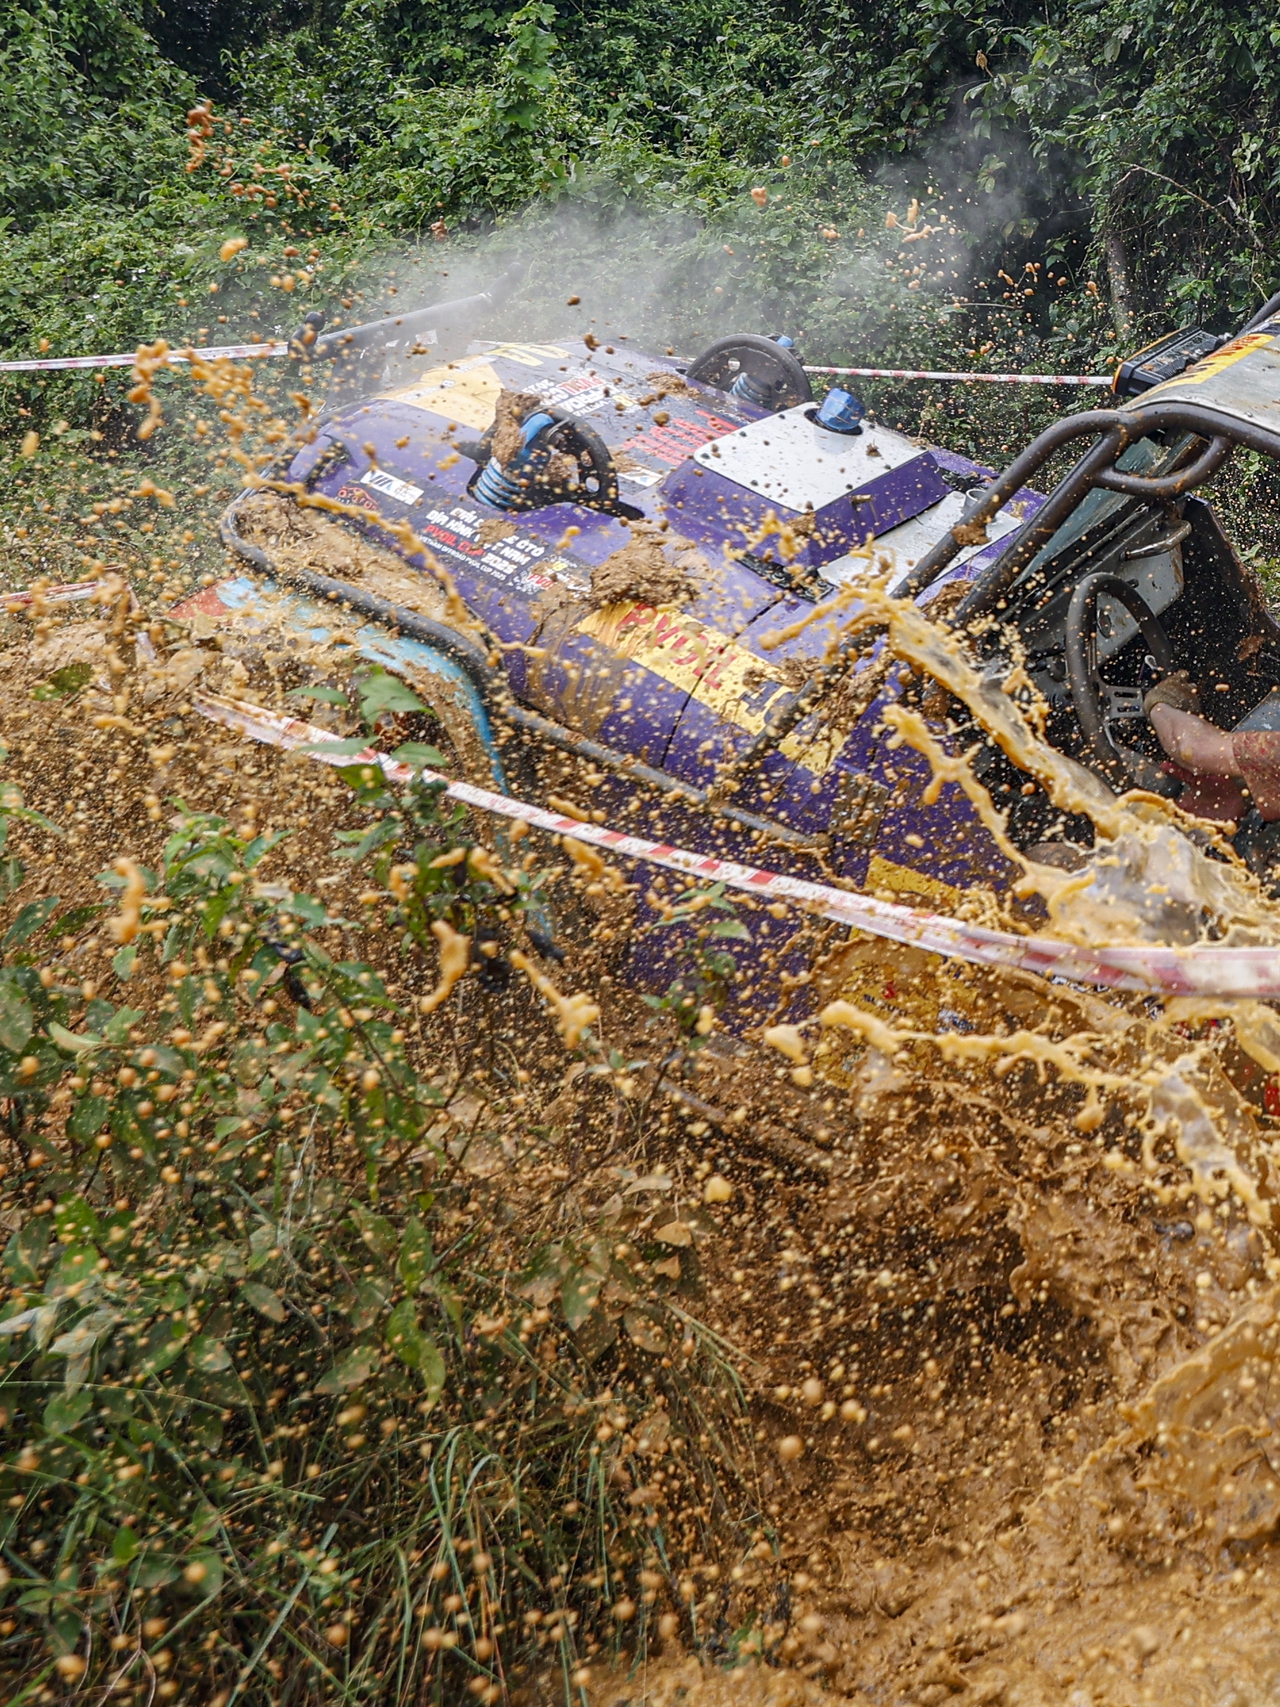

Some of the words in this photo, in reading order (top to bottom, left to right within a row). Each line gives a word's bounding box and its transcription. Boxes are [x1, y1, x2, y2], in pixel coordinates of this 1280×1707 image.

[425, 510, 449, 526] ĐỊA
[424, 524, 459, 547] PVOIL
[500, 545, 532, 566] NAM
[616, 604, 737, 689] PVOIL
